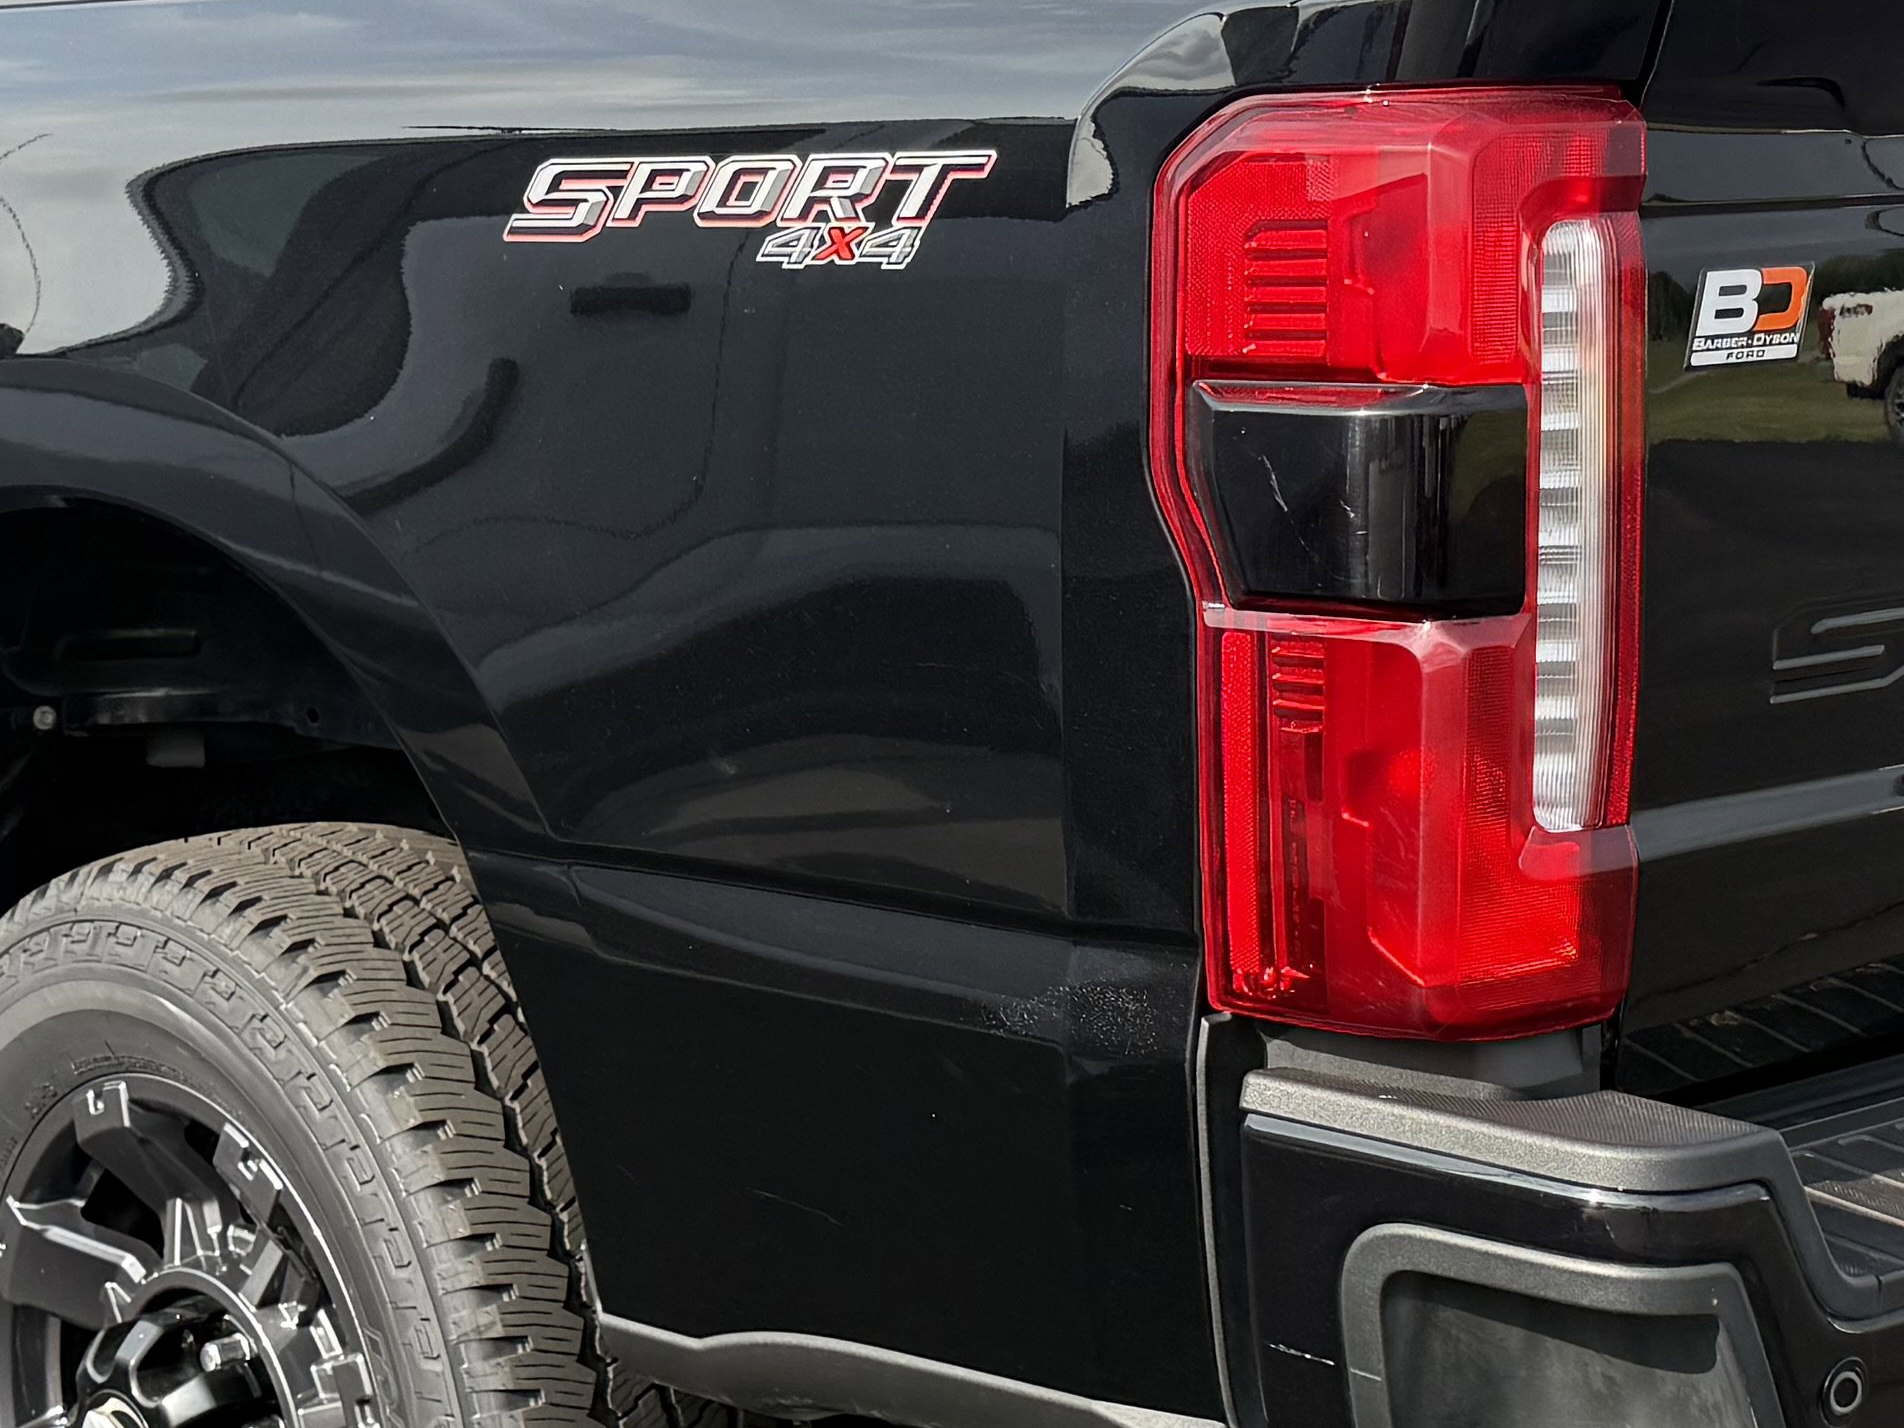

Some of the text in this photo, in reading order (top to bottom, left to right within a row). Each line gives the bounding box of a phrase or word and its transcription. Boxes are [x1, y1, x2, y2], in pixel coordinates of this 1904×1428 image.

[503, 150, 997, 242] SPORT
[1696, 267, 1808, 336] BD
[1726, 349, 1765, 360] FORD
